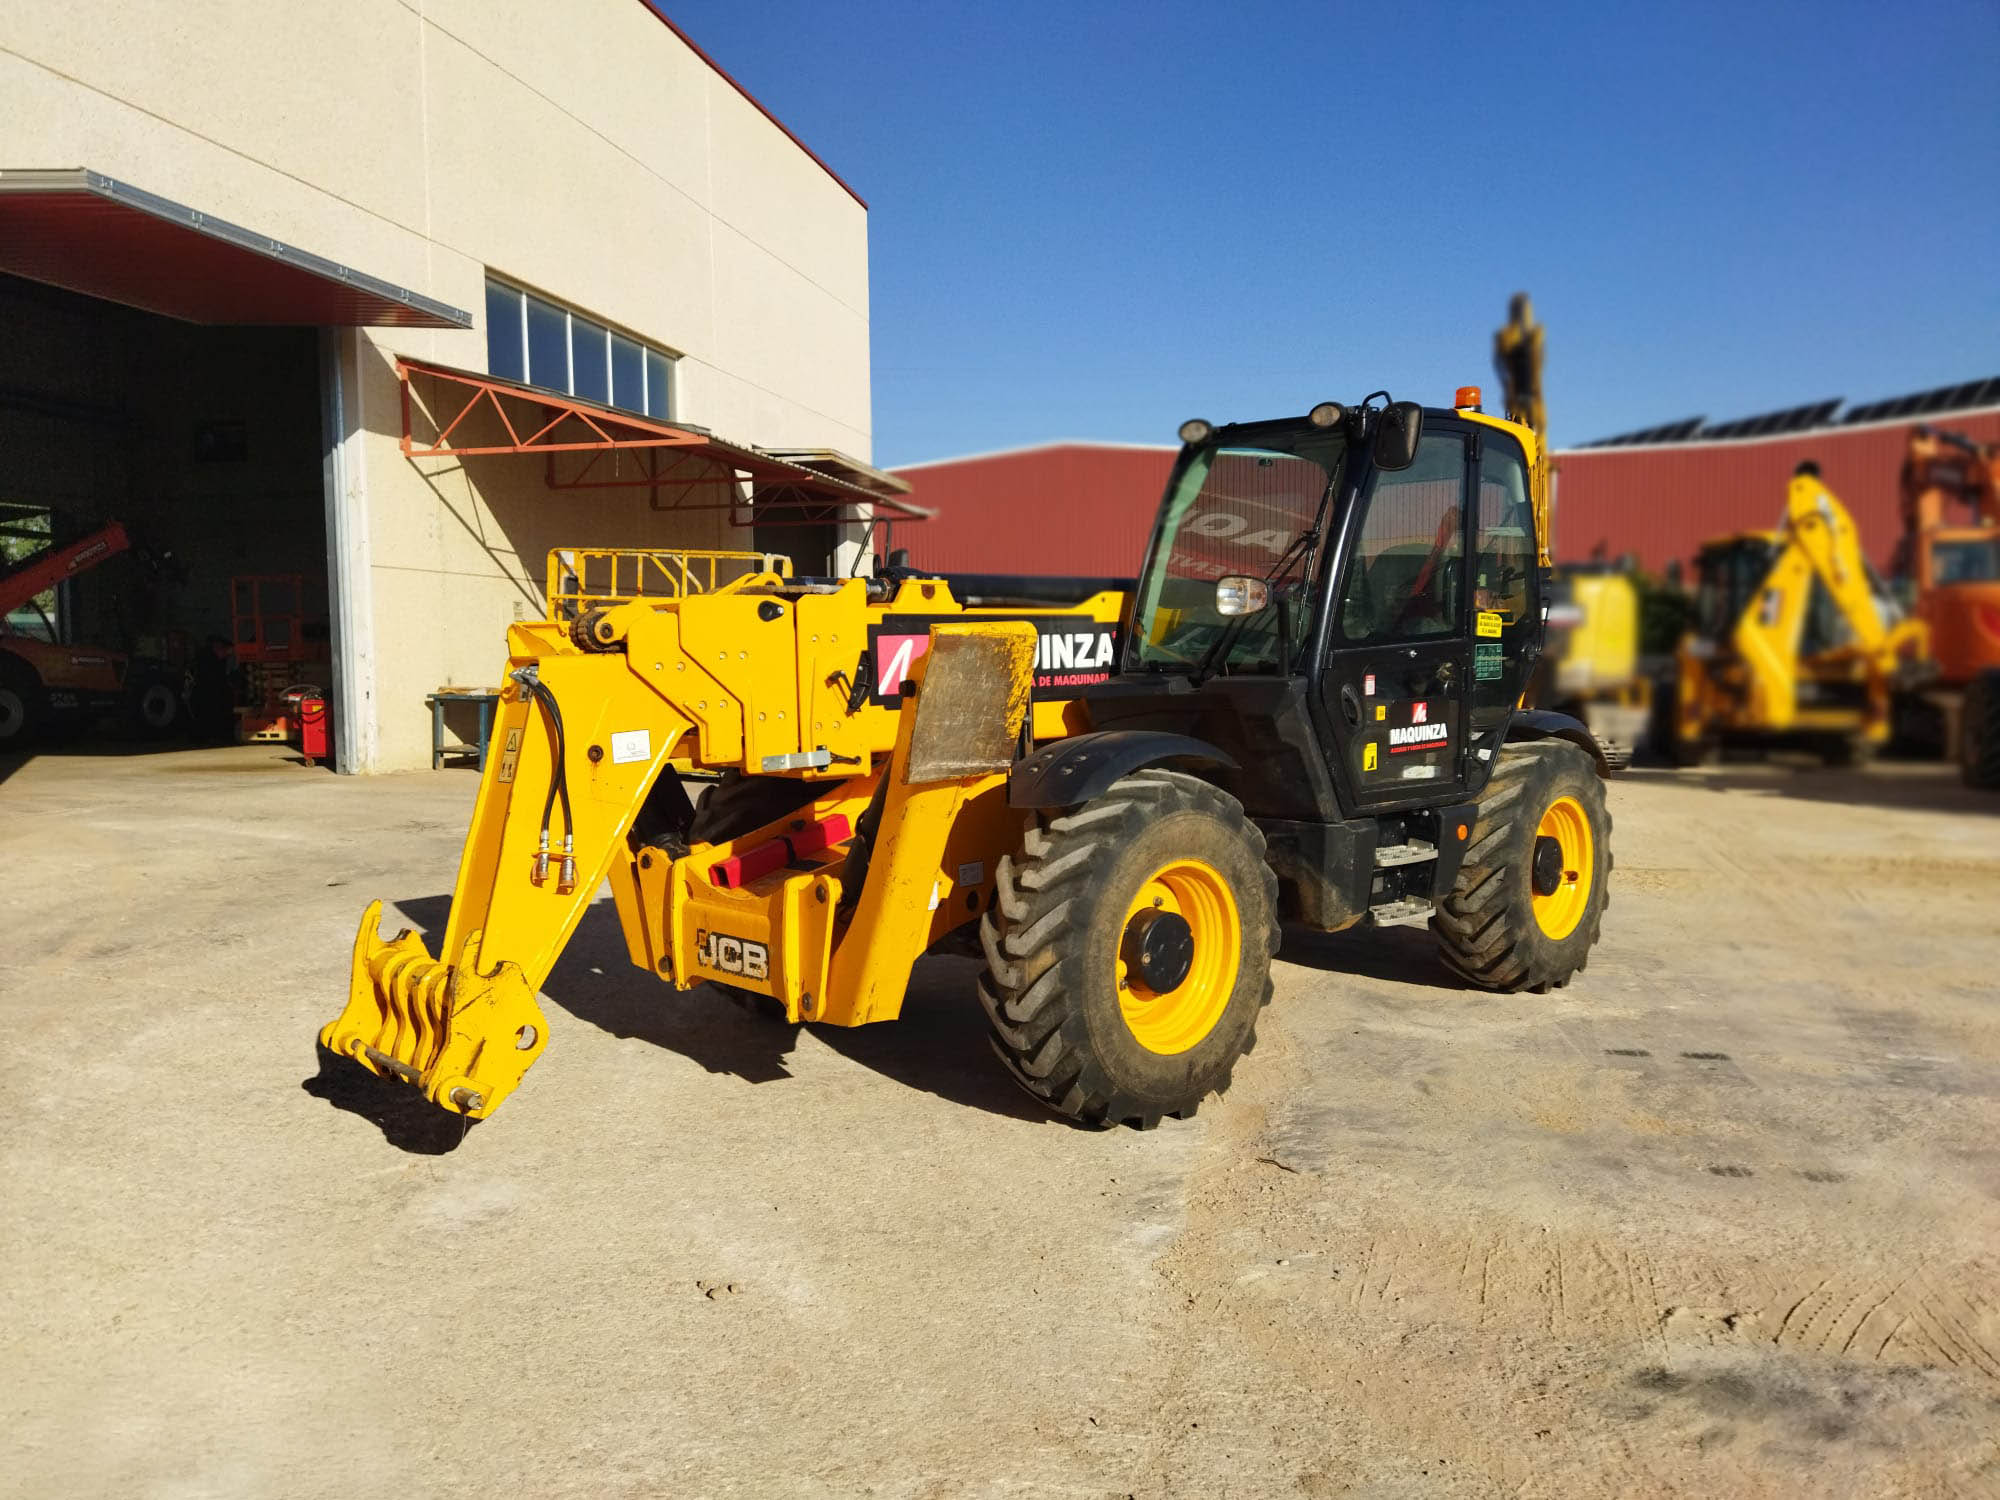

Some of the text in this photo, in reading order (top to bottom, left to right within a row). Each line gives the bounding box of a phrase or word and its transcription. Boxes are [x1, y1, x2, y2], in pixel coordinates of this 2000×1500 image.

[1039, 676, 1051, 687] DE
[1389, 723, 1448, 745] MAQUINZA
[698, 934, 768, 979] JCB
